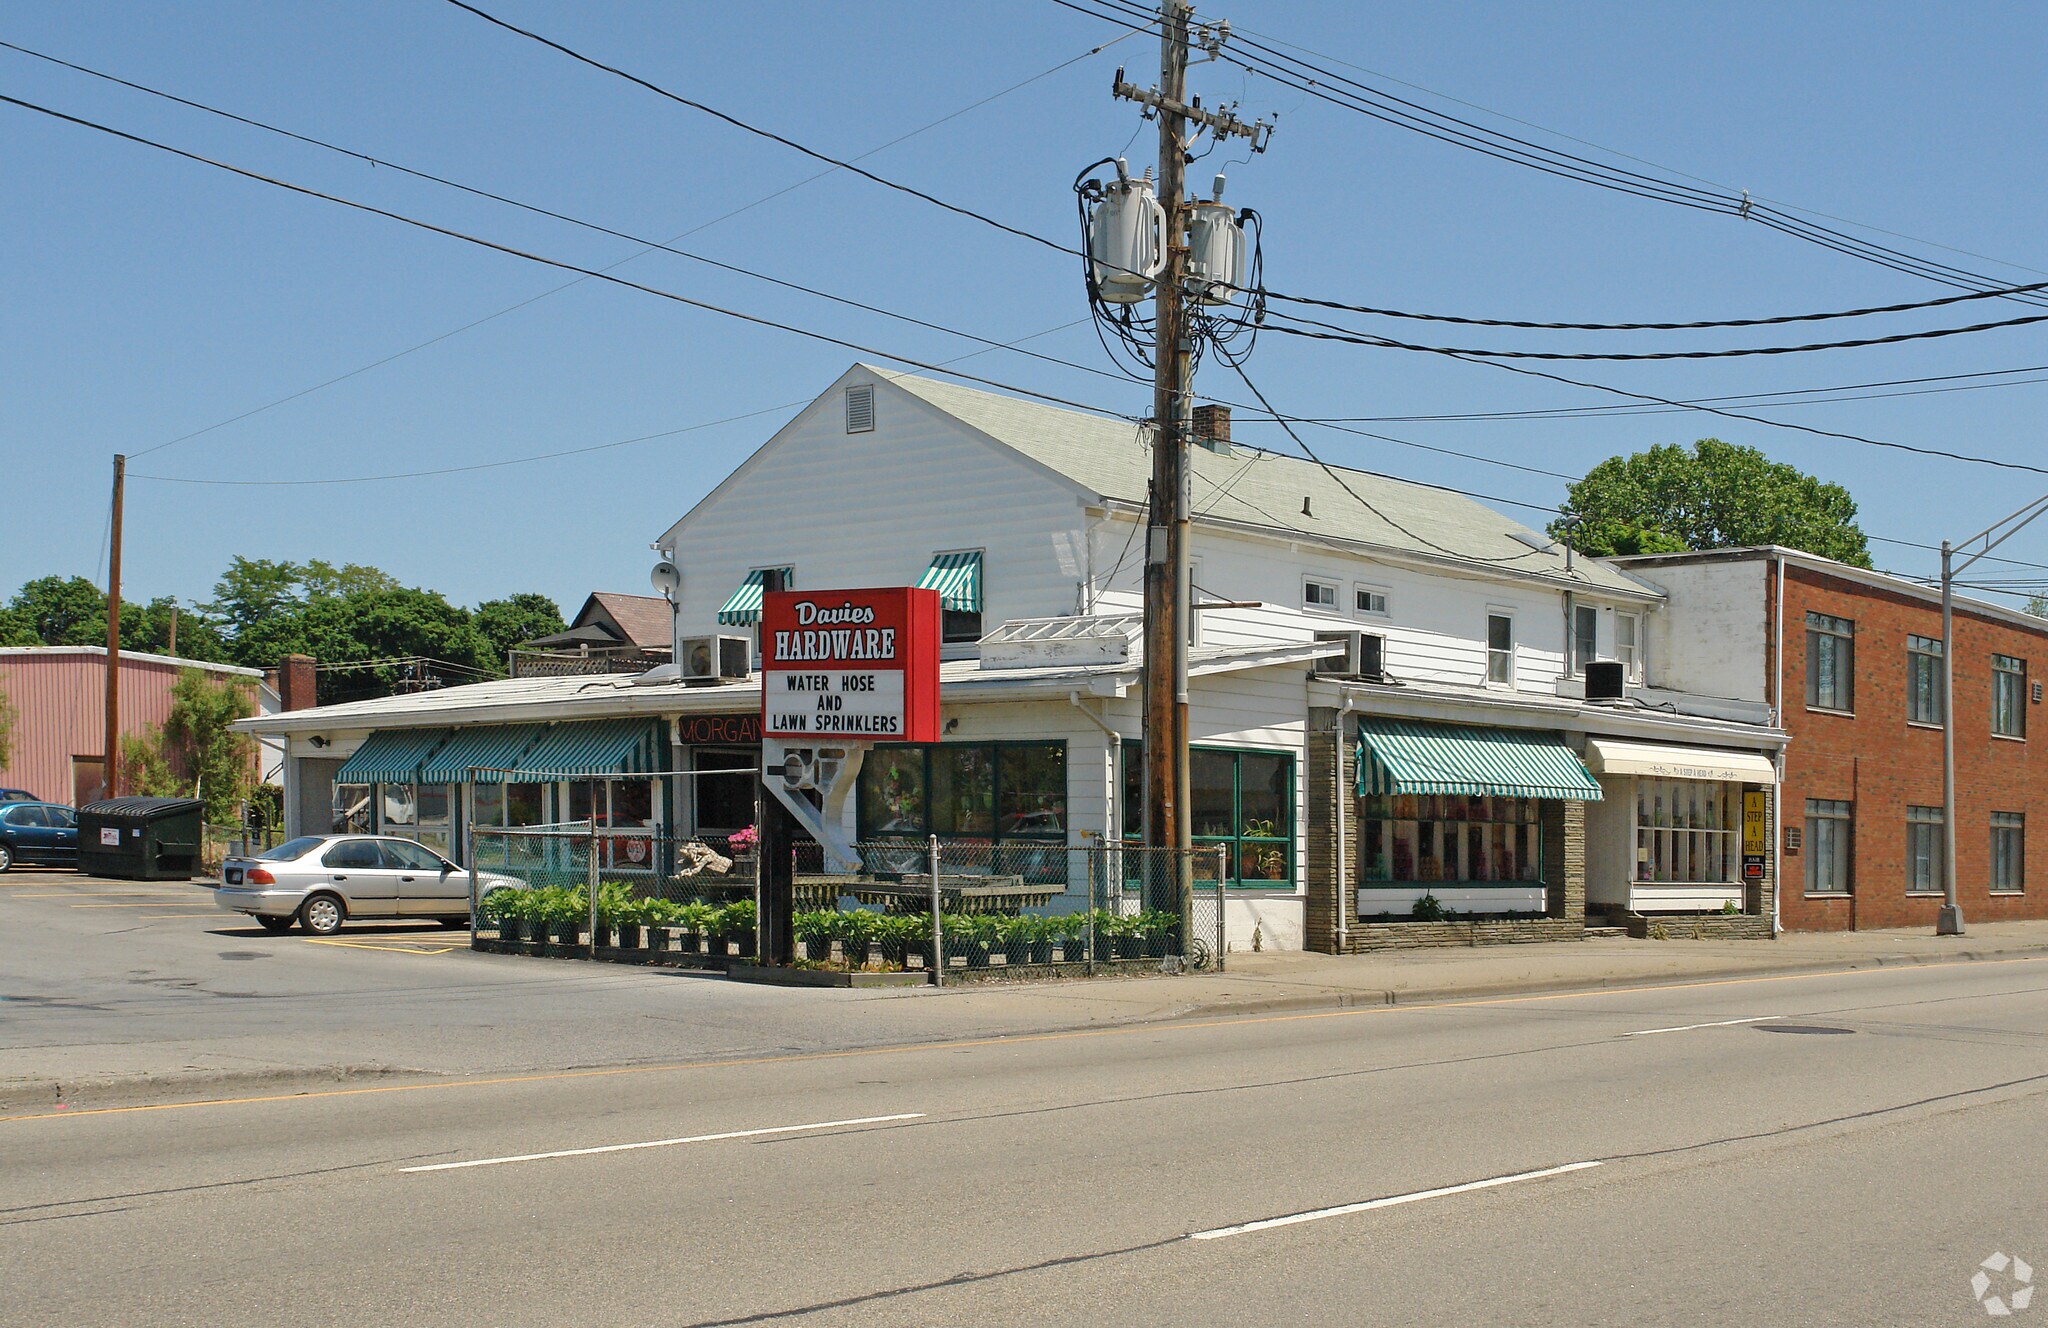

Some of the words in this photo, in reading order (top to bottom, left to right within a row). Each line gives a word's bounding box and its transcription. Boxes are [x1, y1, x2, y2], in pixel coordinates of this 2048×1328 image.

[794, 602, 875, 625] Davies
[774, 628, 895, 661] HARDWARE
[787, 675, 829, 691] WATER
[842, 675, 875, 692] HOSE
[817, 695, 842, 711] AND
[773, 714, 806, 730] LAWN
[815, 714, 897, 733] SPRINKLERS
[1751, 796, 1757, 808] A
[1746, 811, 1762, 823] STEP
[1751, 826, 1757, 837] A
[1745, 841, 1764, 852] HEAD
